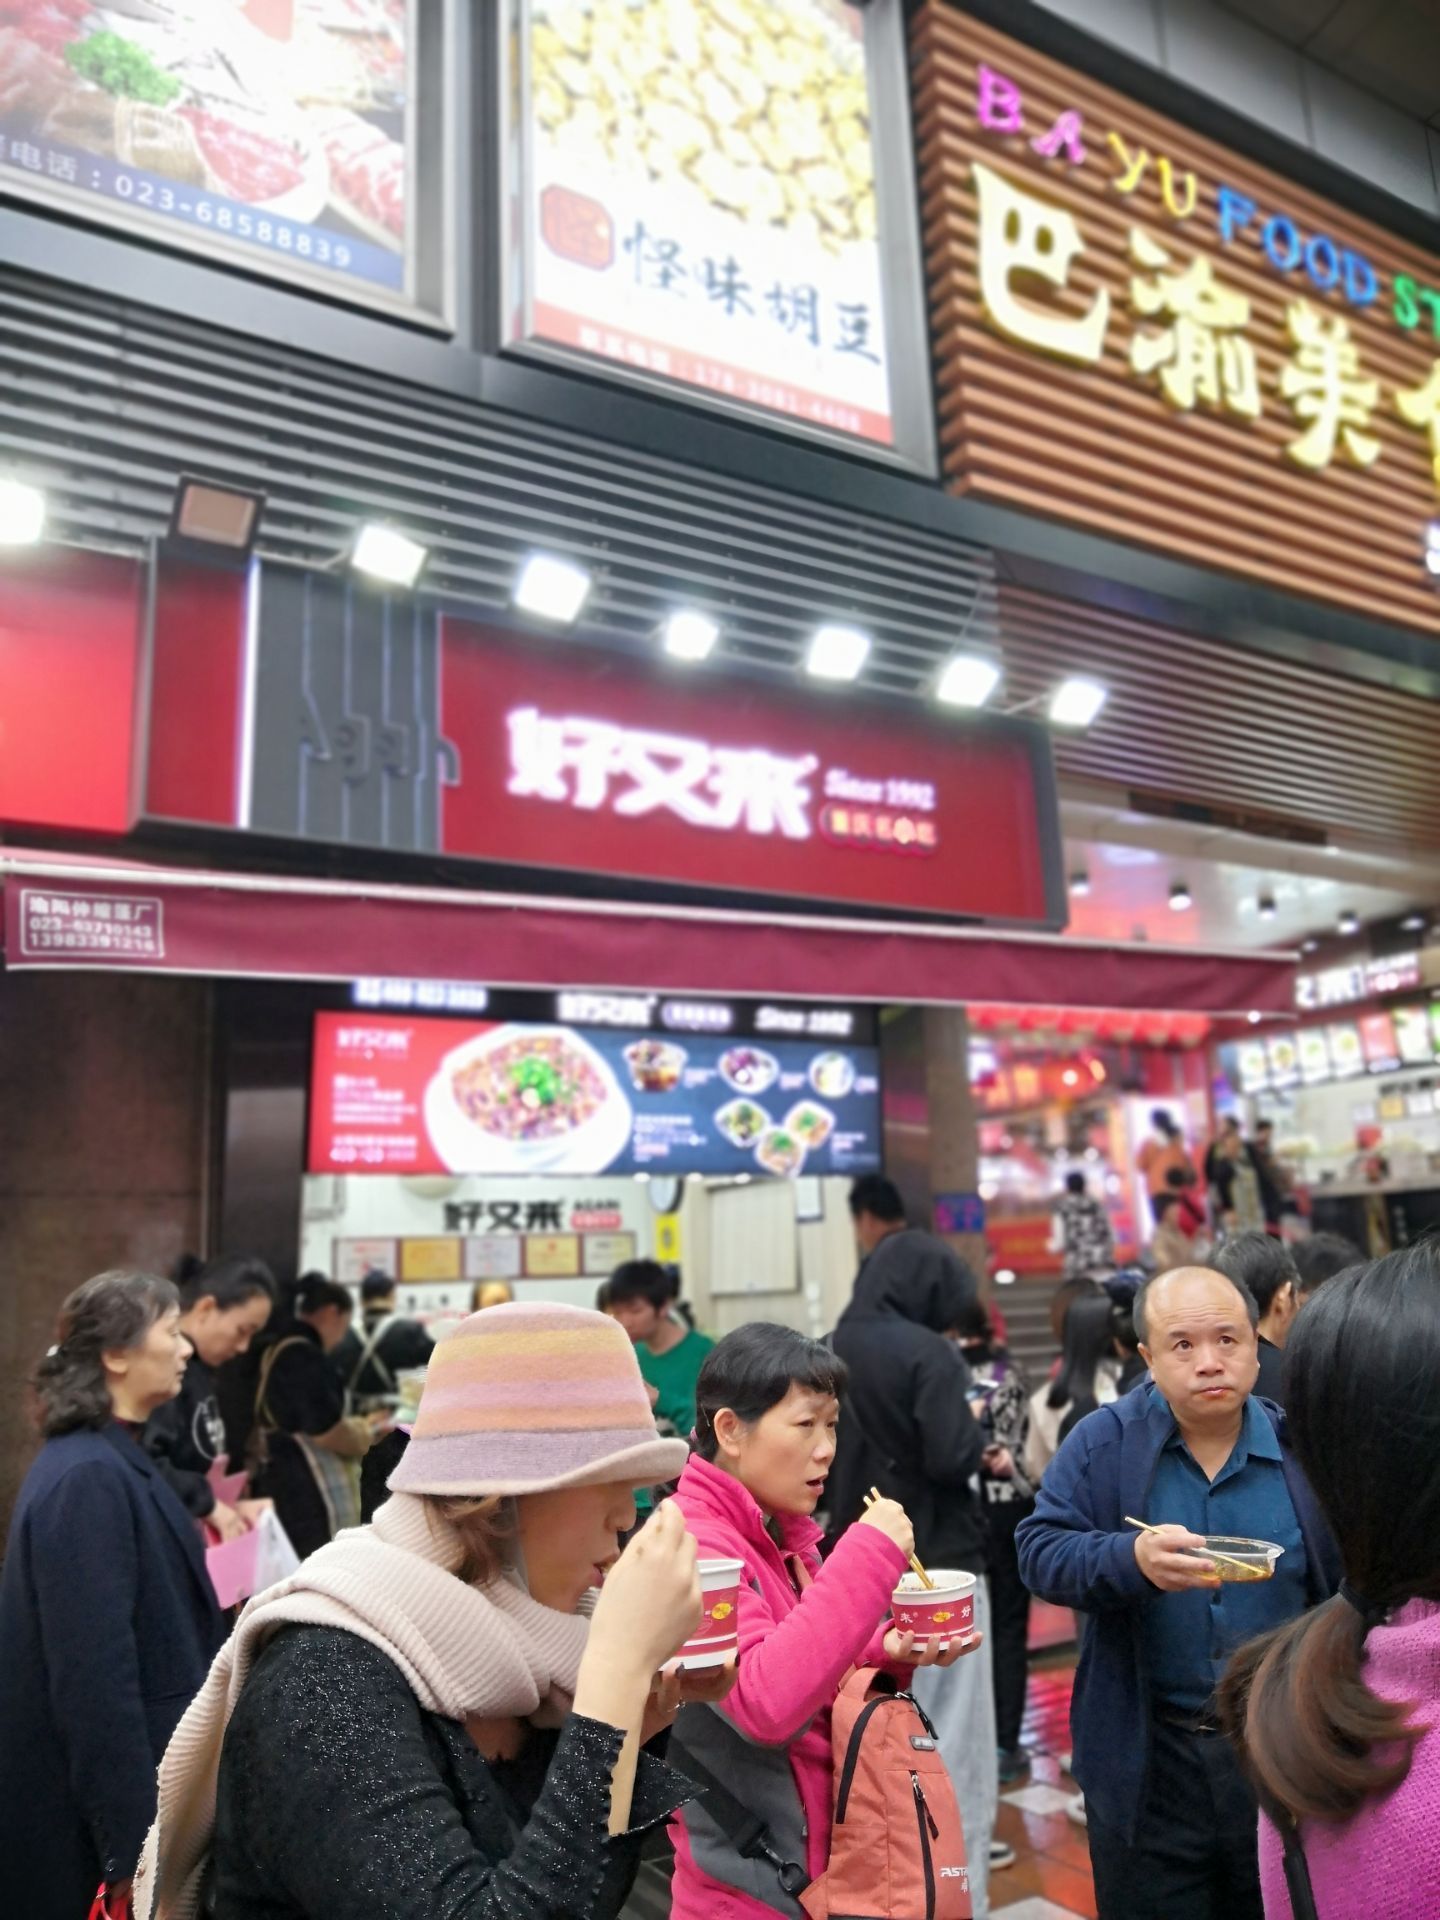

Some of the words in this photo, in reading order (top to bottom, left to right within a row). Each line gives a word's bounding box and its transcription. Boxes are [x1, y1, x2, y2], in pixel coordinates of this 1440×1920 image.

[978, 64, 1197, 218] BAYU
[1217, 184, 1378, 306] FOOD
[622, 218, 882, 366] 怪味胡豆
[506, 706, 820, 841] 好又来
